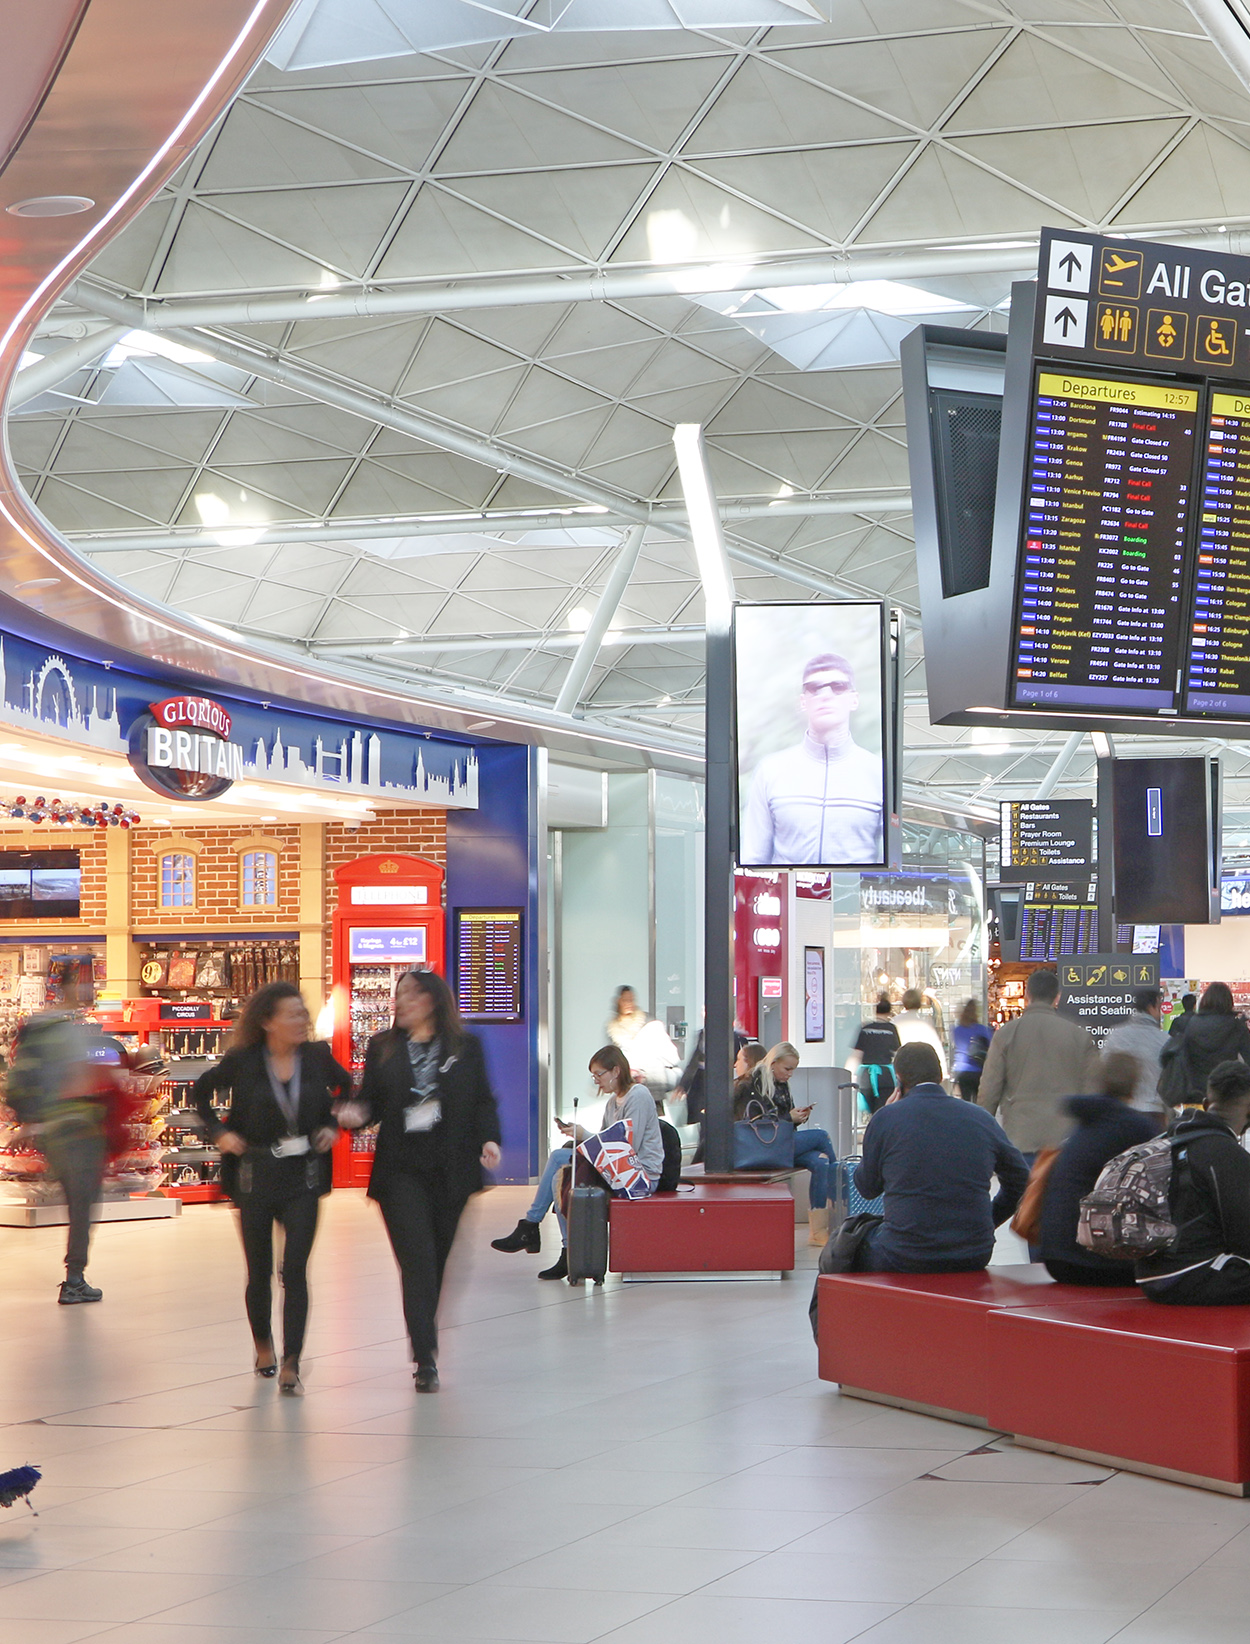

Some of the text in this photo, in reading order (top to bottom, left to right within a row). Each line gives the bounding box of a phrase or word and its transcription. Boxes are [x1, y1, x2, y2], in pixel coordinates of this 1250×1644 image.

[1146, 262, 1190, 298] All
[1062, 380, 1189, 405] Departures 12:57
[1070, 402, 1096, 410] Barcelona
[1134, 409, 1161, 419] Estimating
[1069, 416, 1096, 425] Dortmund
[1061, 516, 1086, 524] Zaragoza
[1023, 690, 1038, 698] Page
[163, 701, 230, 736] GLORIOUS
[148, 727, 243, 780] BRITAIN
[1067, 994, 1122, 1004] Assistance
[1079, 1006, 1098, 1015] and
